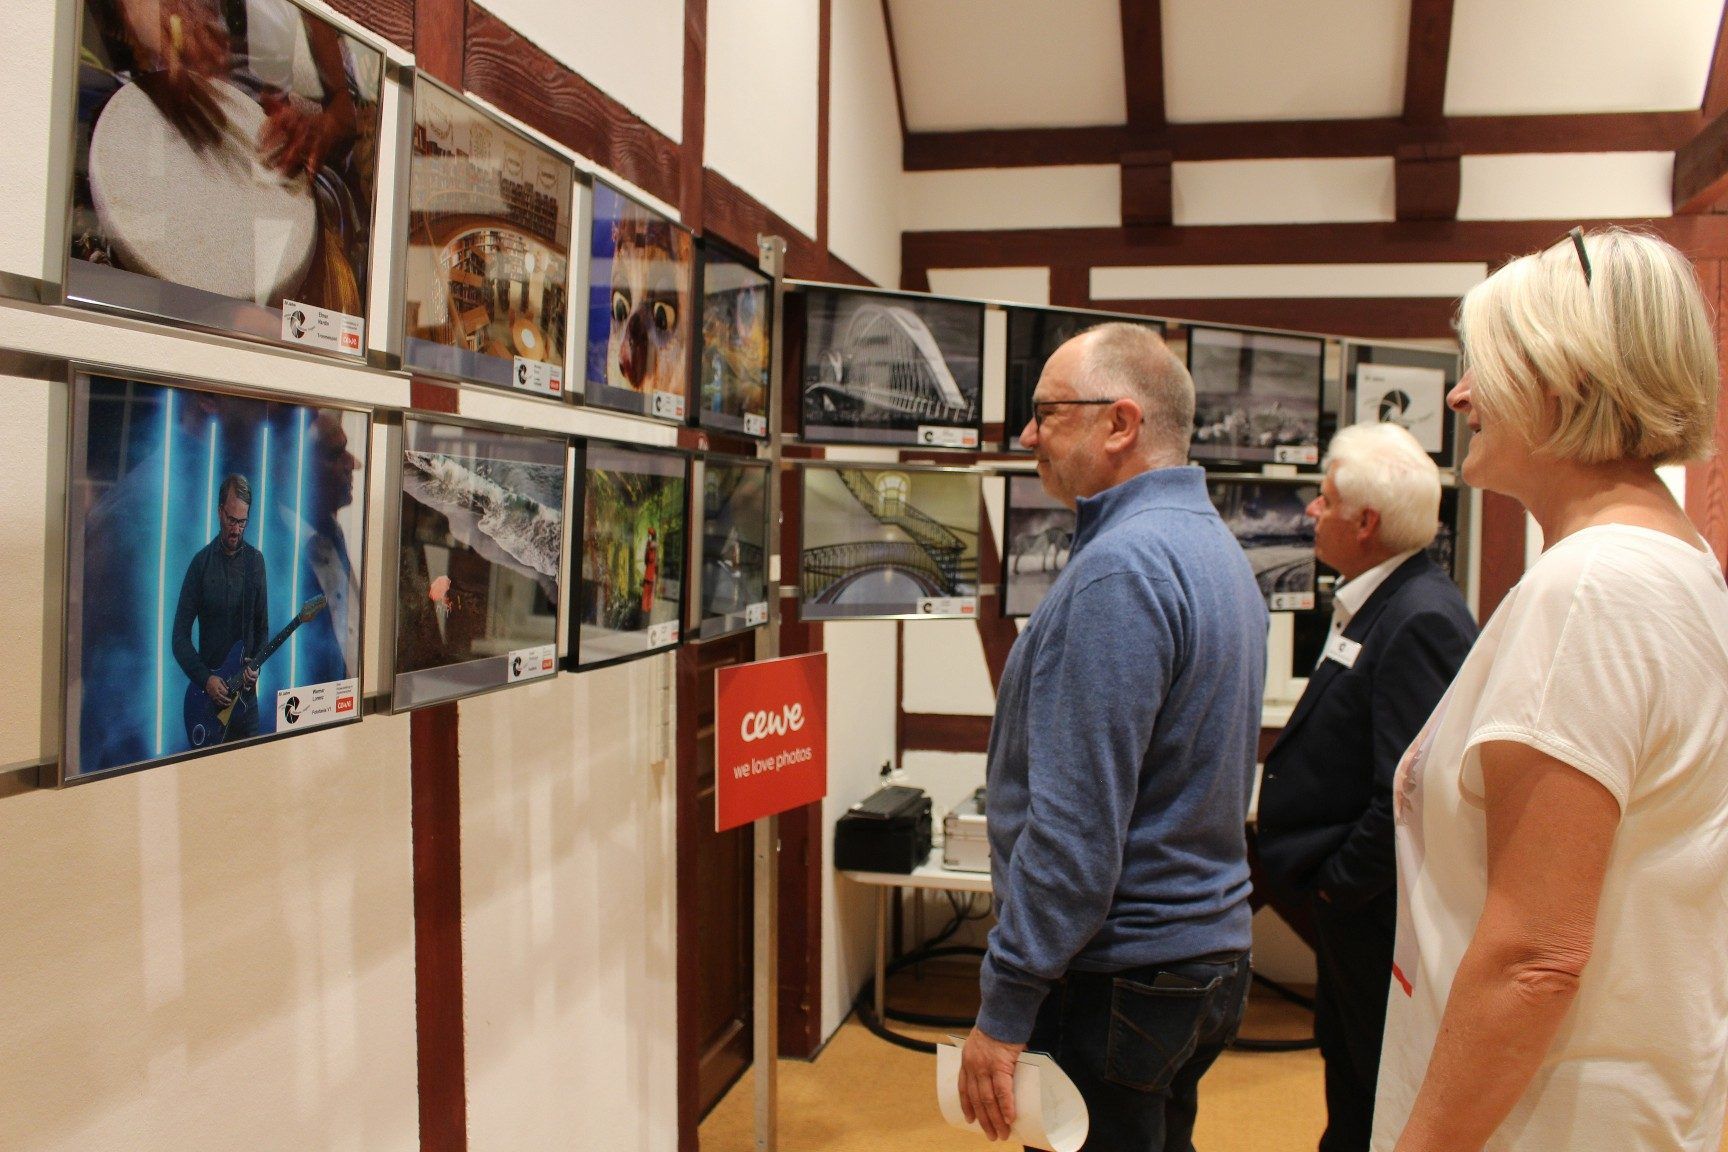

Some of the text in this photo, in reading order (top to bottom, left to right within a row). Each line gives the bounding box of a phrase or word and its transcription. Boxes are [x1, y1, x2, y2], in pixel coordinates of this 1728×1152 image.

[740, 702, 805, 743] cewe
[733, 746, 813, 779] we love photos
